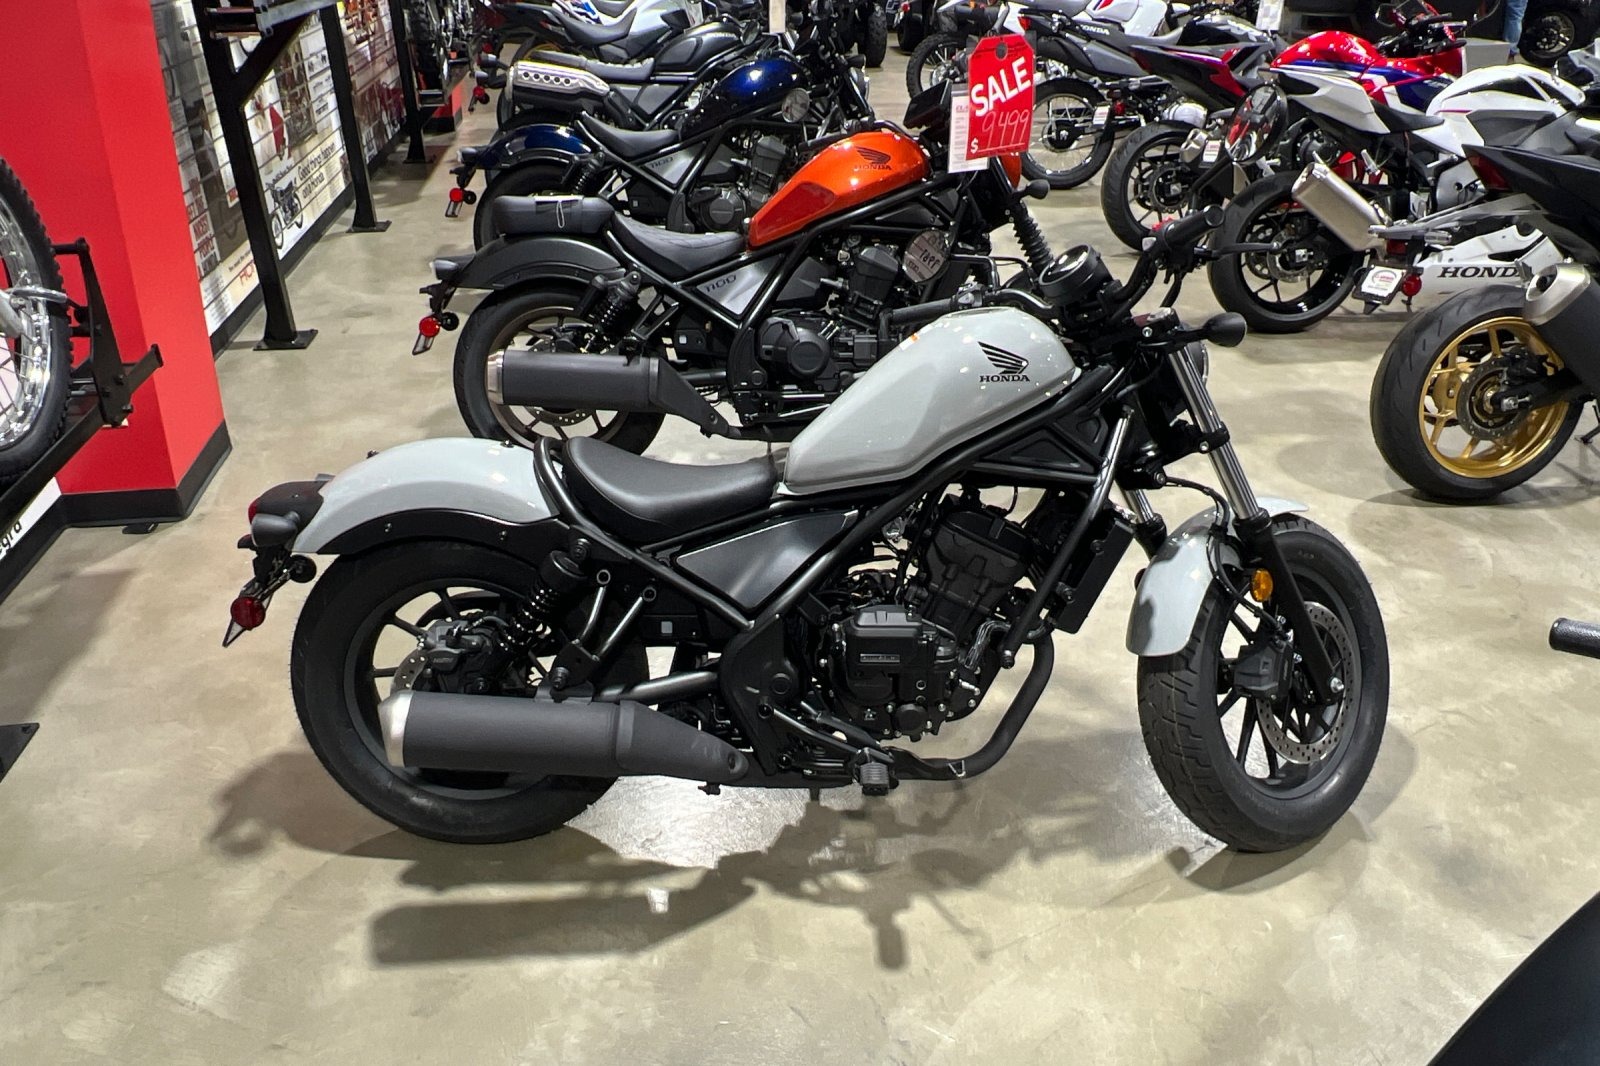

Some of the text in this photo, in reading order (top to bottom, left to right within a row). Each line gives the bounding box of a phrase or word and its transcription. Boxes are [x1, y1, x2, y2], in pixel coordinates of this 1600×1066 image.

[971, 56, 1031, 117] SALE
[970, 137, 979, 154] $
[705, 274, 737, 292] 1100
[979, 374, 1031, 383] HONDA
